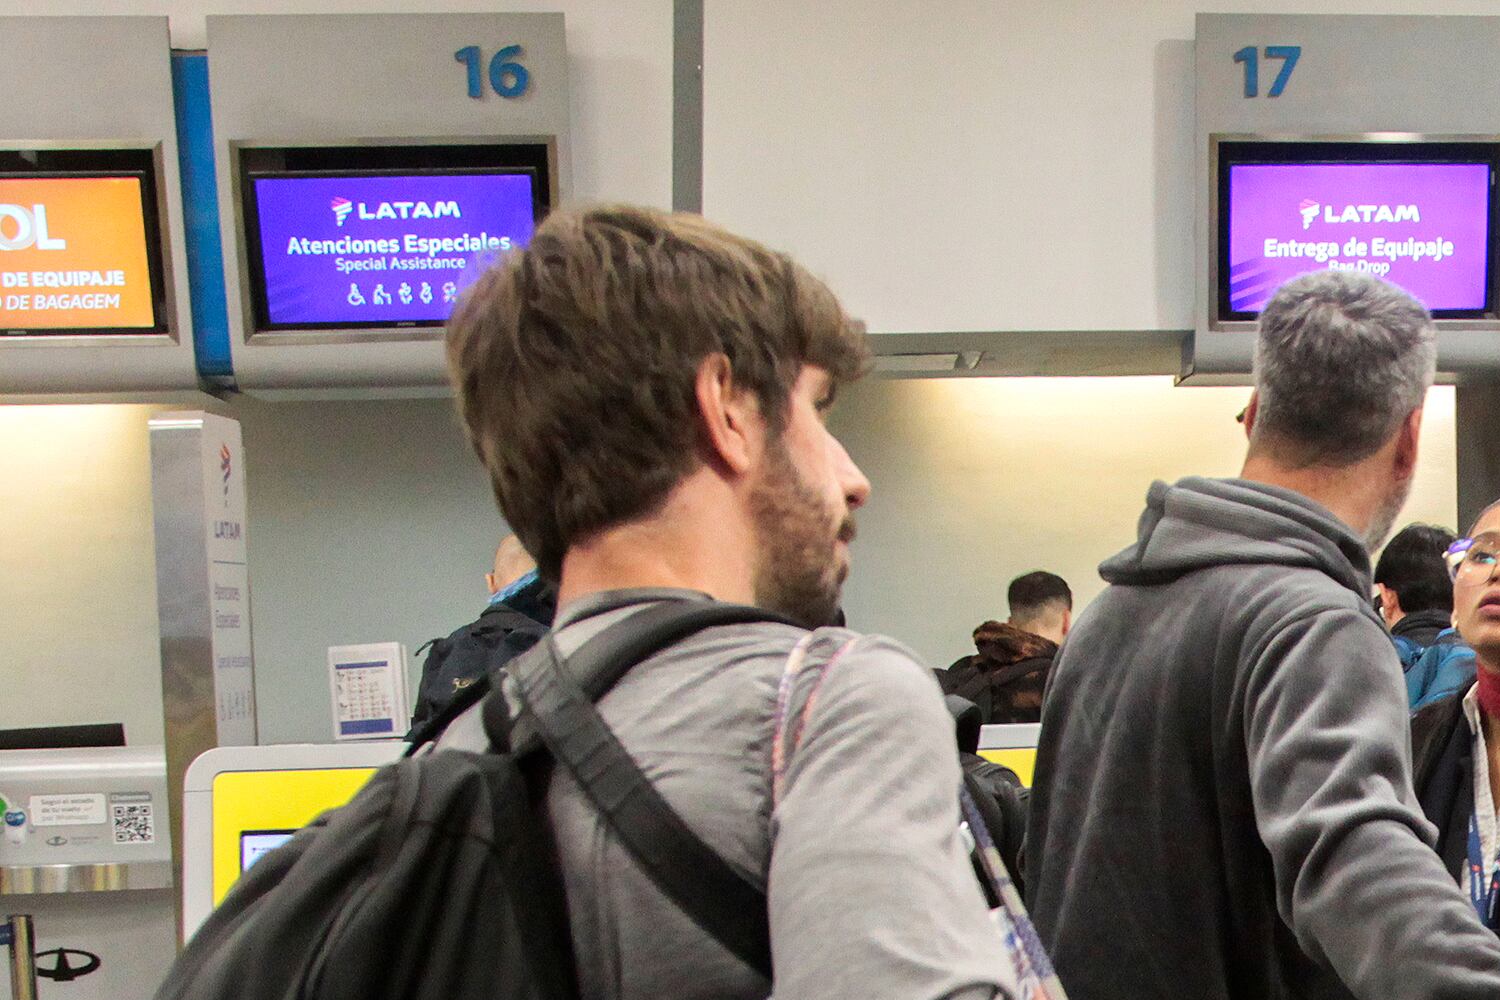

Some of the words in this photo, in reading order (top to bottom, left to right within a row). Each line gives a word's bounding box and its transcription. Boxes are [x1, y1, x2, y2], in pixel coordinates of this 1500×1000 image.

[455, 45, 529, 98] 16
[1233, 46, 1301, 98] 17
[358, 201, 461, 219] LATAM
[1324, 205, 1420, 223] LATAM
[0, 203, 66, 251] OL
[287, 236, 400, 254] Atenciones
[404, 232, 511, 257] Especiales
[1264, 238, 1339, 262] Entrega
[1343, 237, 1368, 257] de
[1371, 237, 1454, 262] Equipaje
[336, 257, 387, 273] Special
[390, 256, 466, 270] Assistance
[1357, 259, 1390, 277] Drop
[2, 271, 29, 288] DE
[32, 270, 125, 288] EQUIPAJE
[6, 294, 30, 310] DE
[34, 294, 120, 310] BAGAGEM
